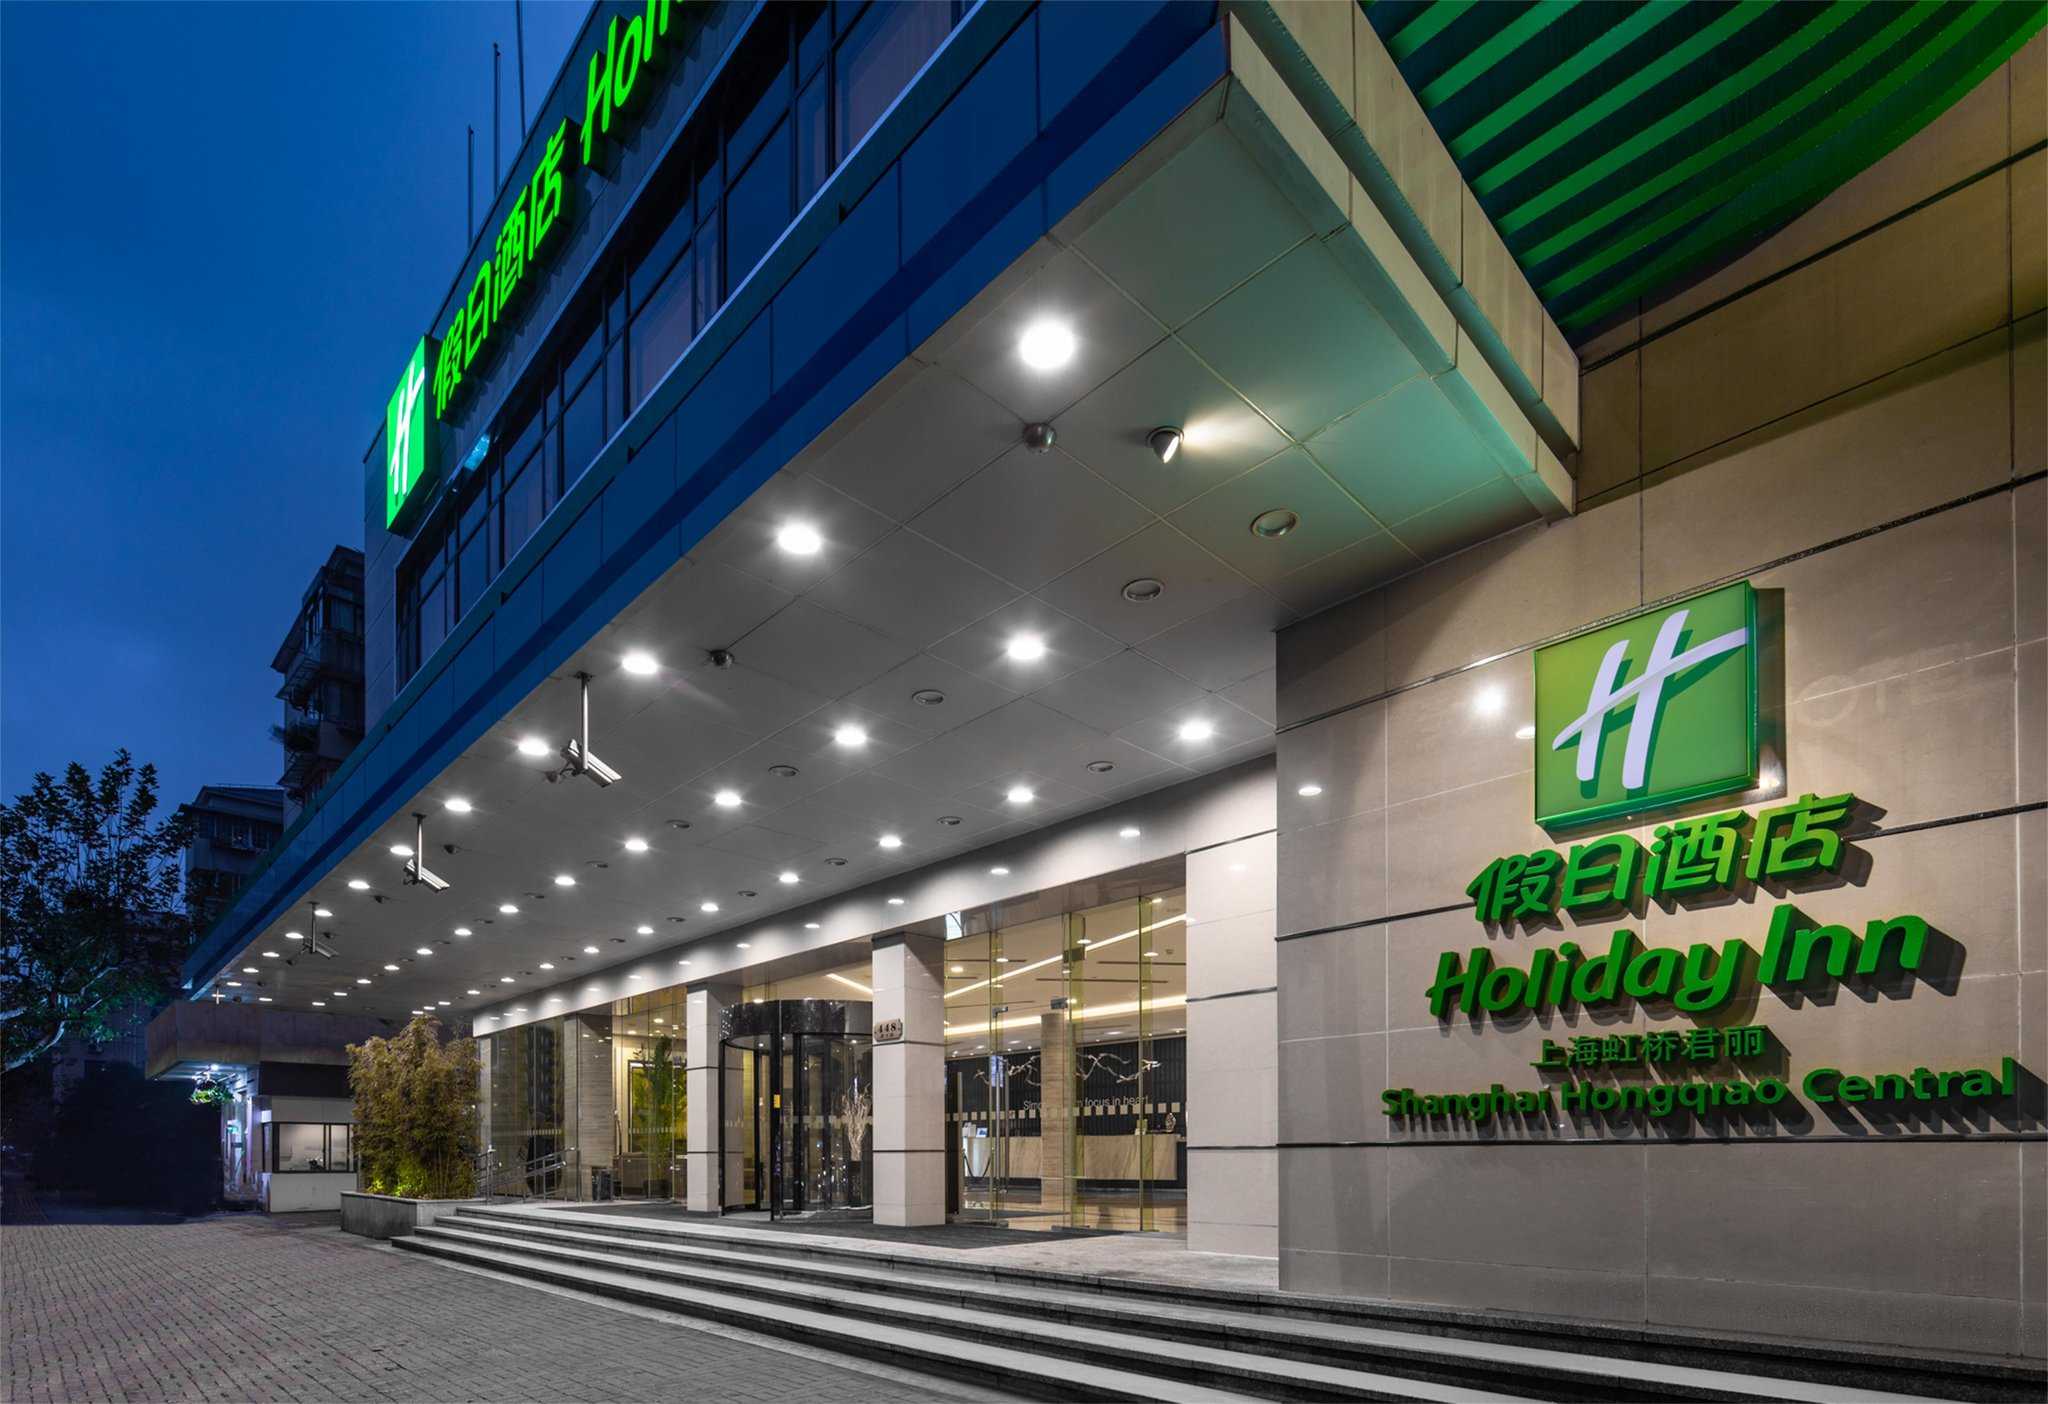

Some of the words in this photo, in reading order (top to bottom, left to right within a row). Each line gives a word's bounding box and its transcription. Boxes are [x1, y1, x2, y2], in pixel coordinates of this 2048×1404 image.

[433, 118, 566, 420] 假日酒店
[1466, 793, 1855, 922] 假日酒店
[1426, 929, 1748, 1016] Holiday
[1757, 905, 1929, 985] Inn
[1382, 1084, 1552, 1119] Shanghai
[1561, 1077, 1788, 1116] Hongqiao
[1803, 1056, 2017, 1101] Central
[1530, 1025, 1767, 1068] 上海虹桥君丽
